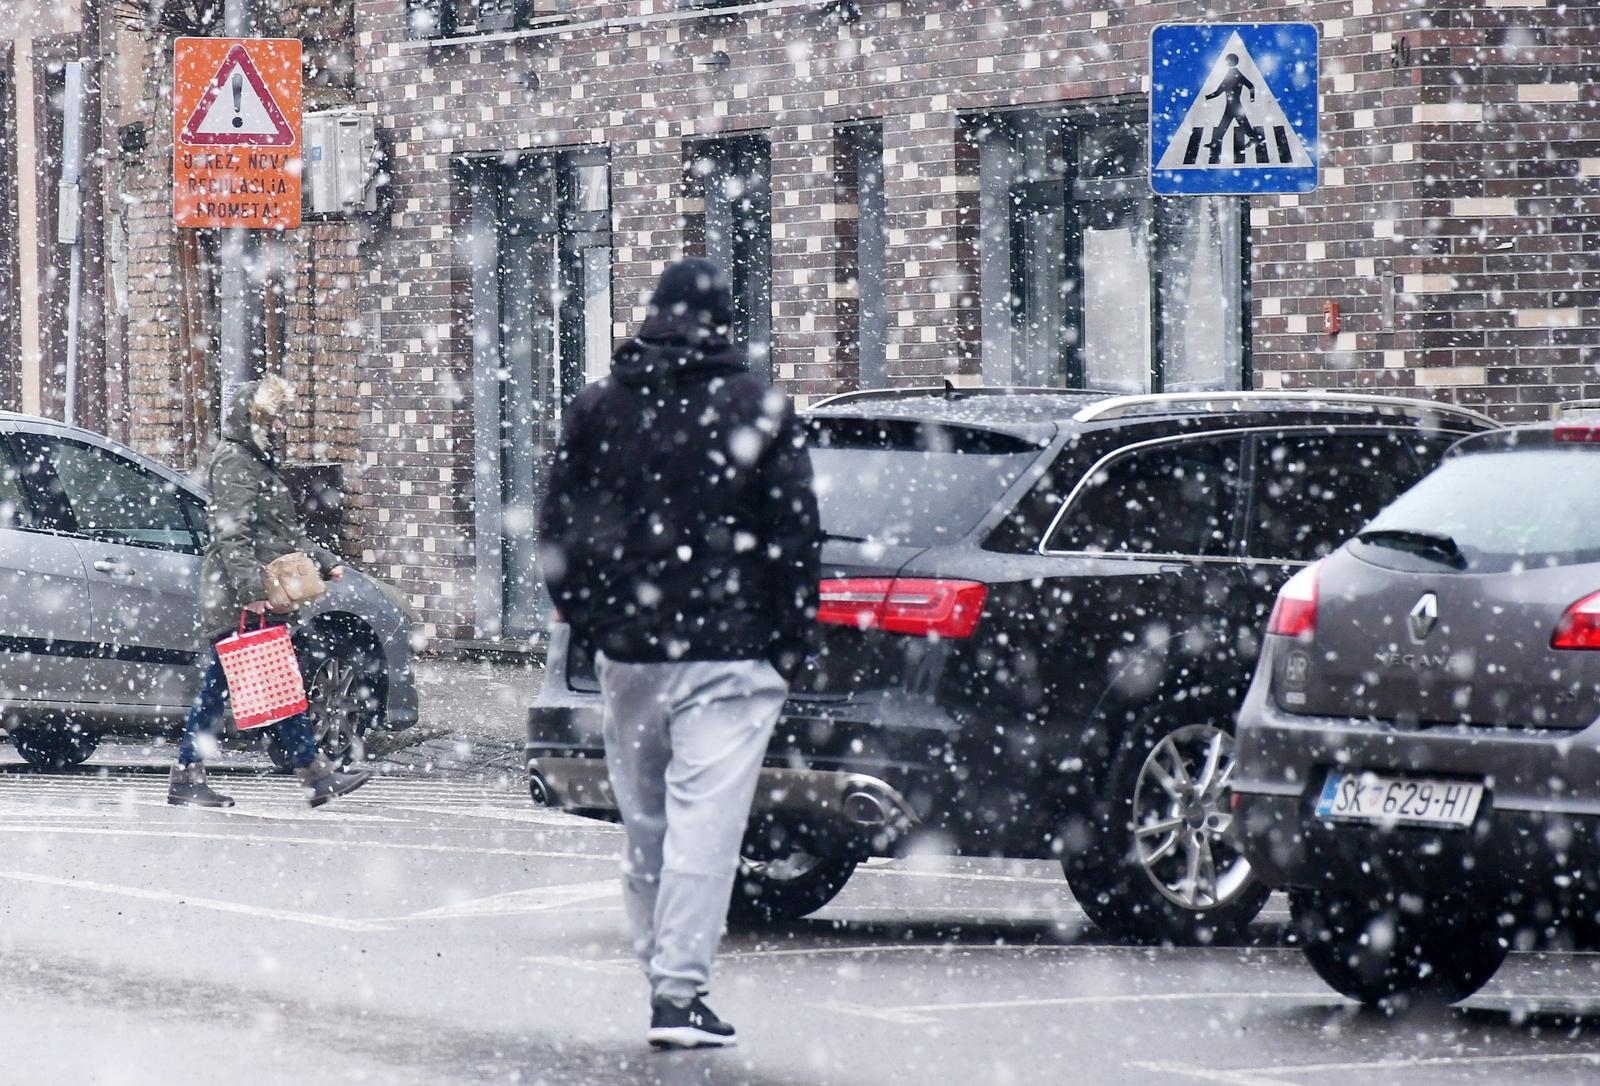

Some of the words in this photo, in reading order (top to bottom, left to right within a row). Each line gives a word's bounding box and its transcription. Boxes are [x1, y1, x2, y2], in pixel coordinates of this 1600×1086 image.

[197, 202, 278, 218] PROMETA!
[1374, 652, 1459, 667] MEGAN
[1336, 780, 1366, 812] SK
